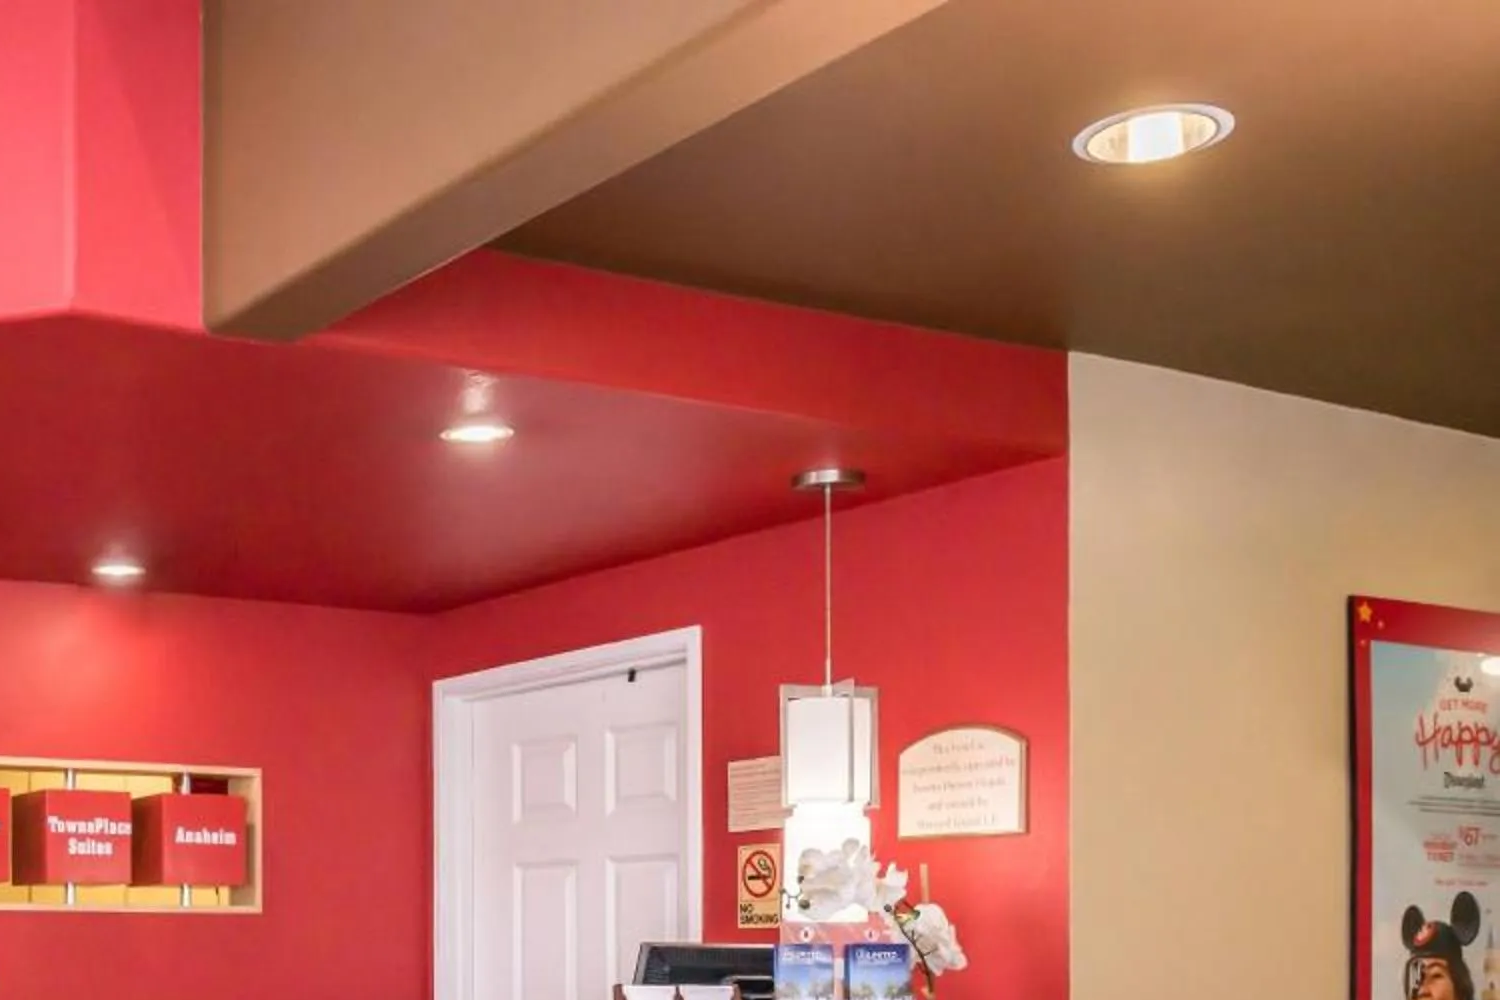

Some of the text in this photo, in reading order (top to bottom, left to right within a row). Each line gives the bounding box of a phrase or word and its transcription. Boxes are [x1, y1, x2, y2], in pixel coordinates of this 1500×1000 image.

[47, 815, 132, 836] TownePlace
[175, 826, 237, 846] Anaheim
[67, 837, 114, 856] Suites
[740, 903, 754, 914] NO
[740, 913, 779, 926] SMOKING
